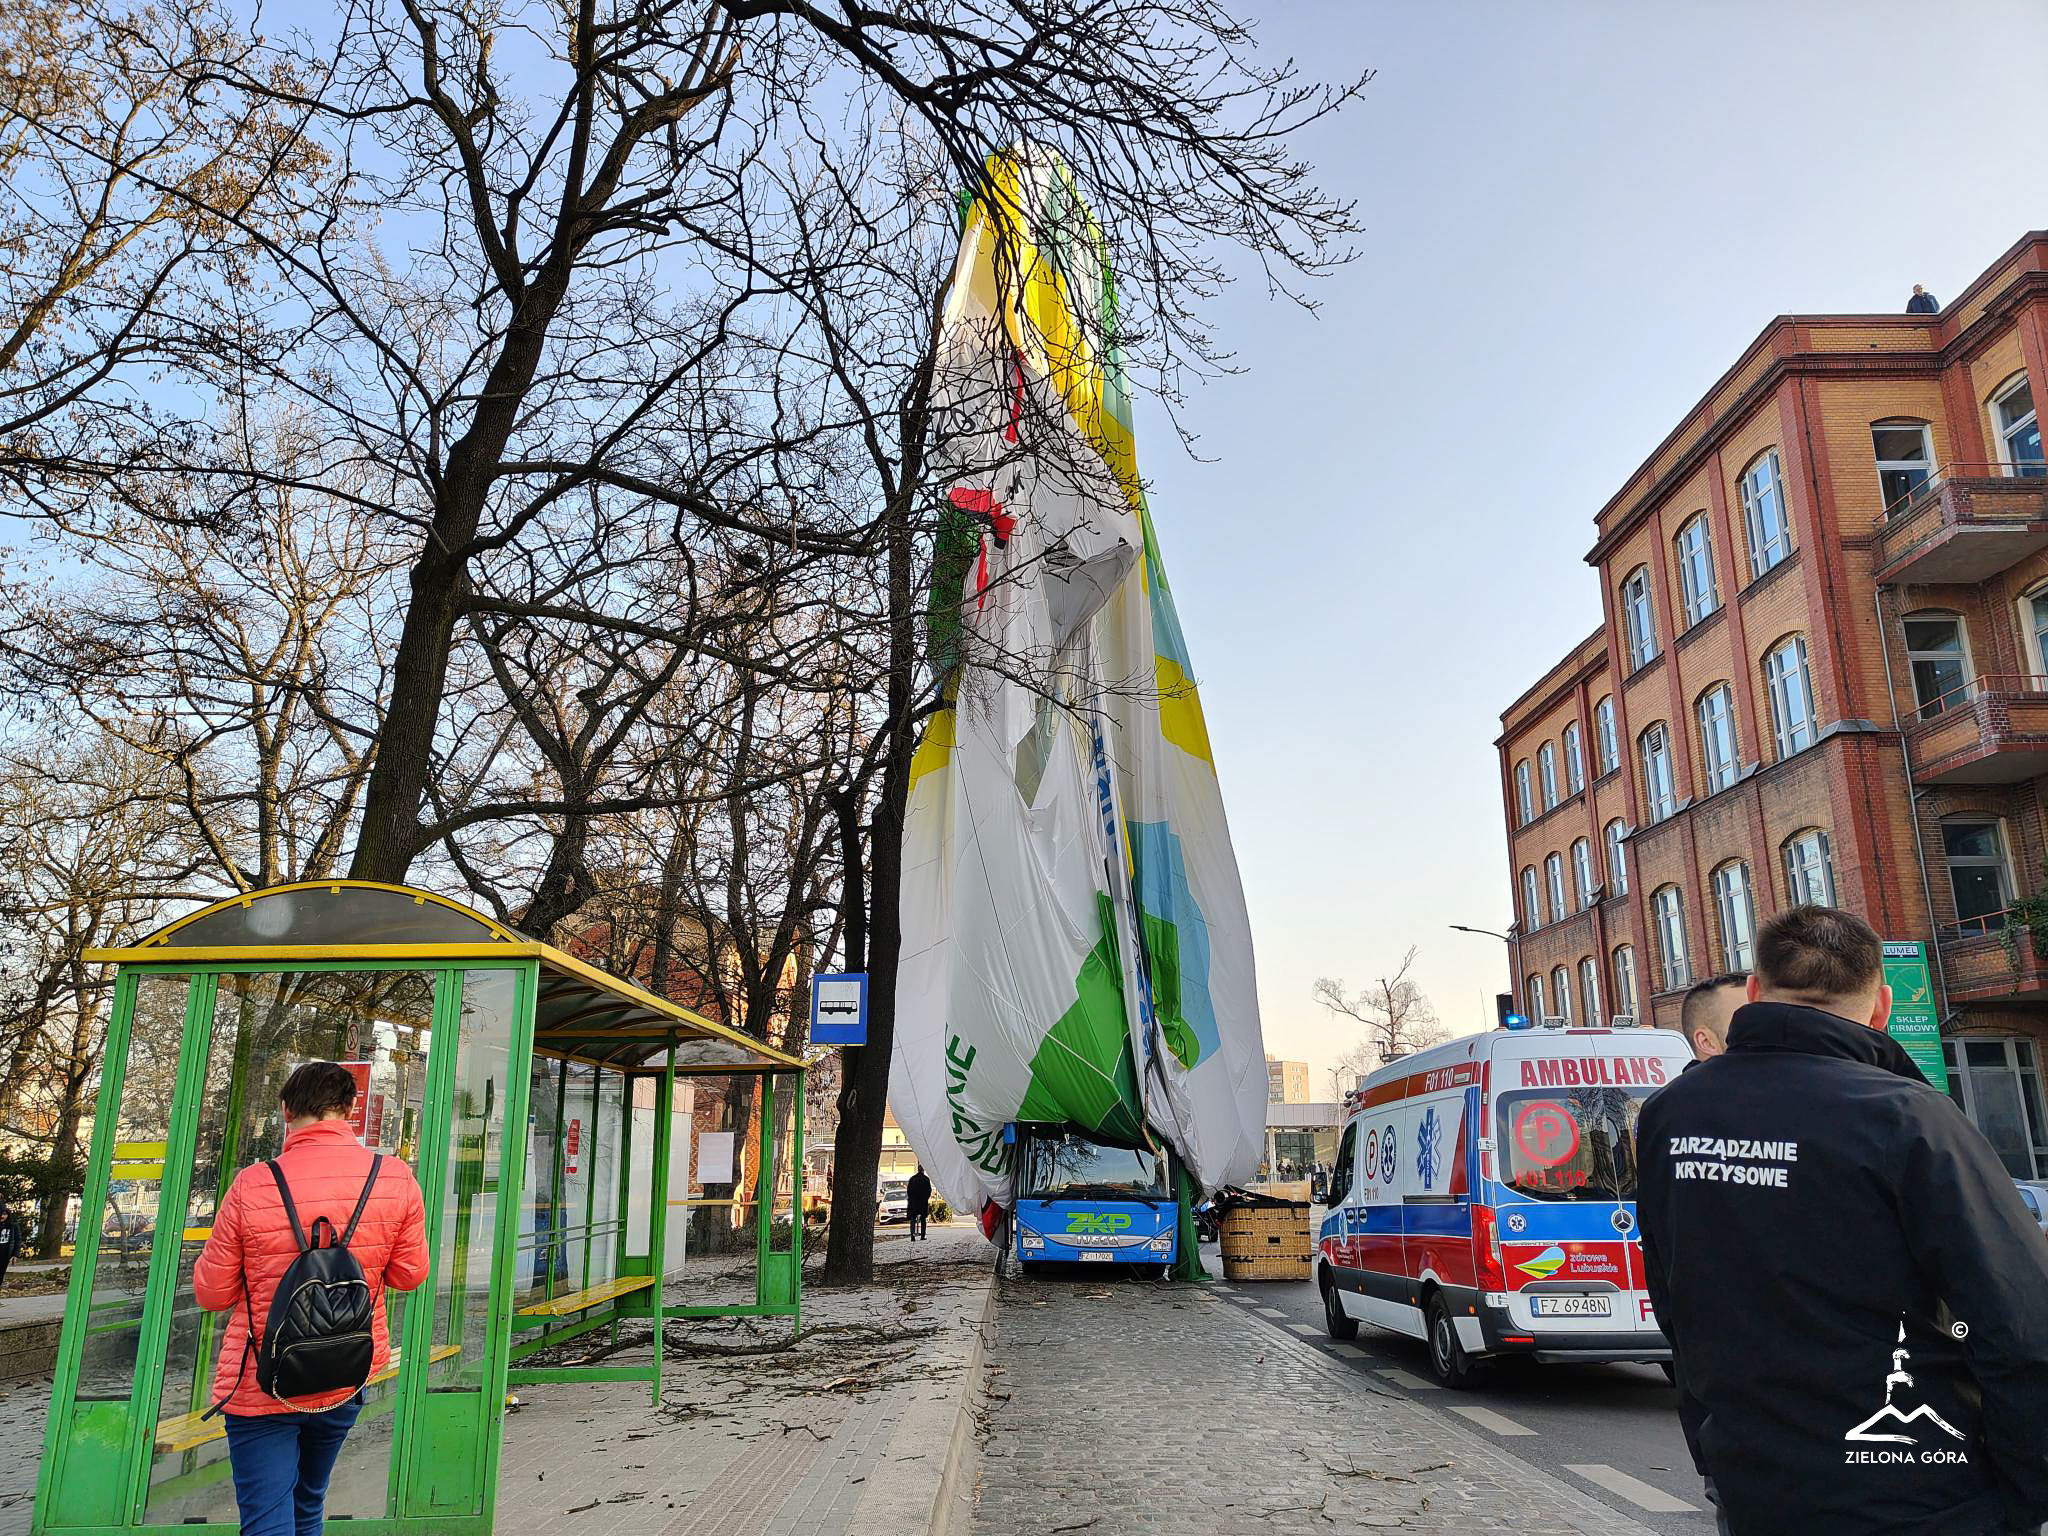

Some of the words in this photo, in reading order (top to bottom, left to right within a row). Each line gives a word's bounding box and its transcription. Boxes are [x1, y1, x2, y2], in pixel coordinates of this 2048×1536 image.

[1885, 946, 1918, 954] LUMEL
[1890, 1024, 1937, 1032] FIRMOWY
[1424, 1072, 1440, 1093] F01
[1441, 1067, 1454, 1089] 110
[1520, 1057, 1666, 1087] AMBULANS
[1536, 1115, 1561, 1152] P
[1669, 1136, 1798, 1161] ZARZĄDZANIE
[1675, 1161, 1788, 1187] KRYZYSOWE
[1066, 1212, 1132, 1233] ZKP
[1076, 1235, 1119, 1246] IVECO
[1569, 1252, 1608, 1262] zdrowe
[1541, 1299, 1560, 1313] FZ
[1564, 1299, 1607, 1313] 6948N
